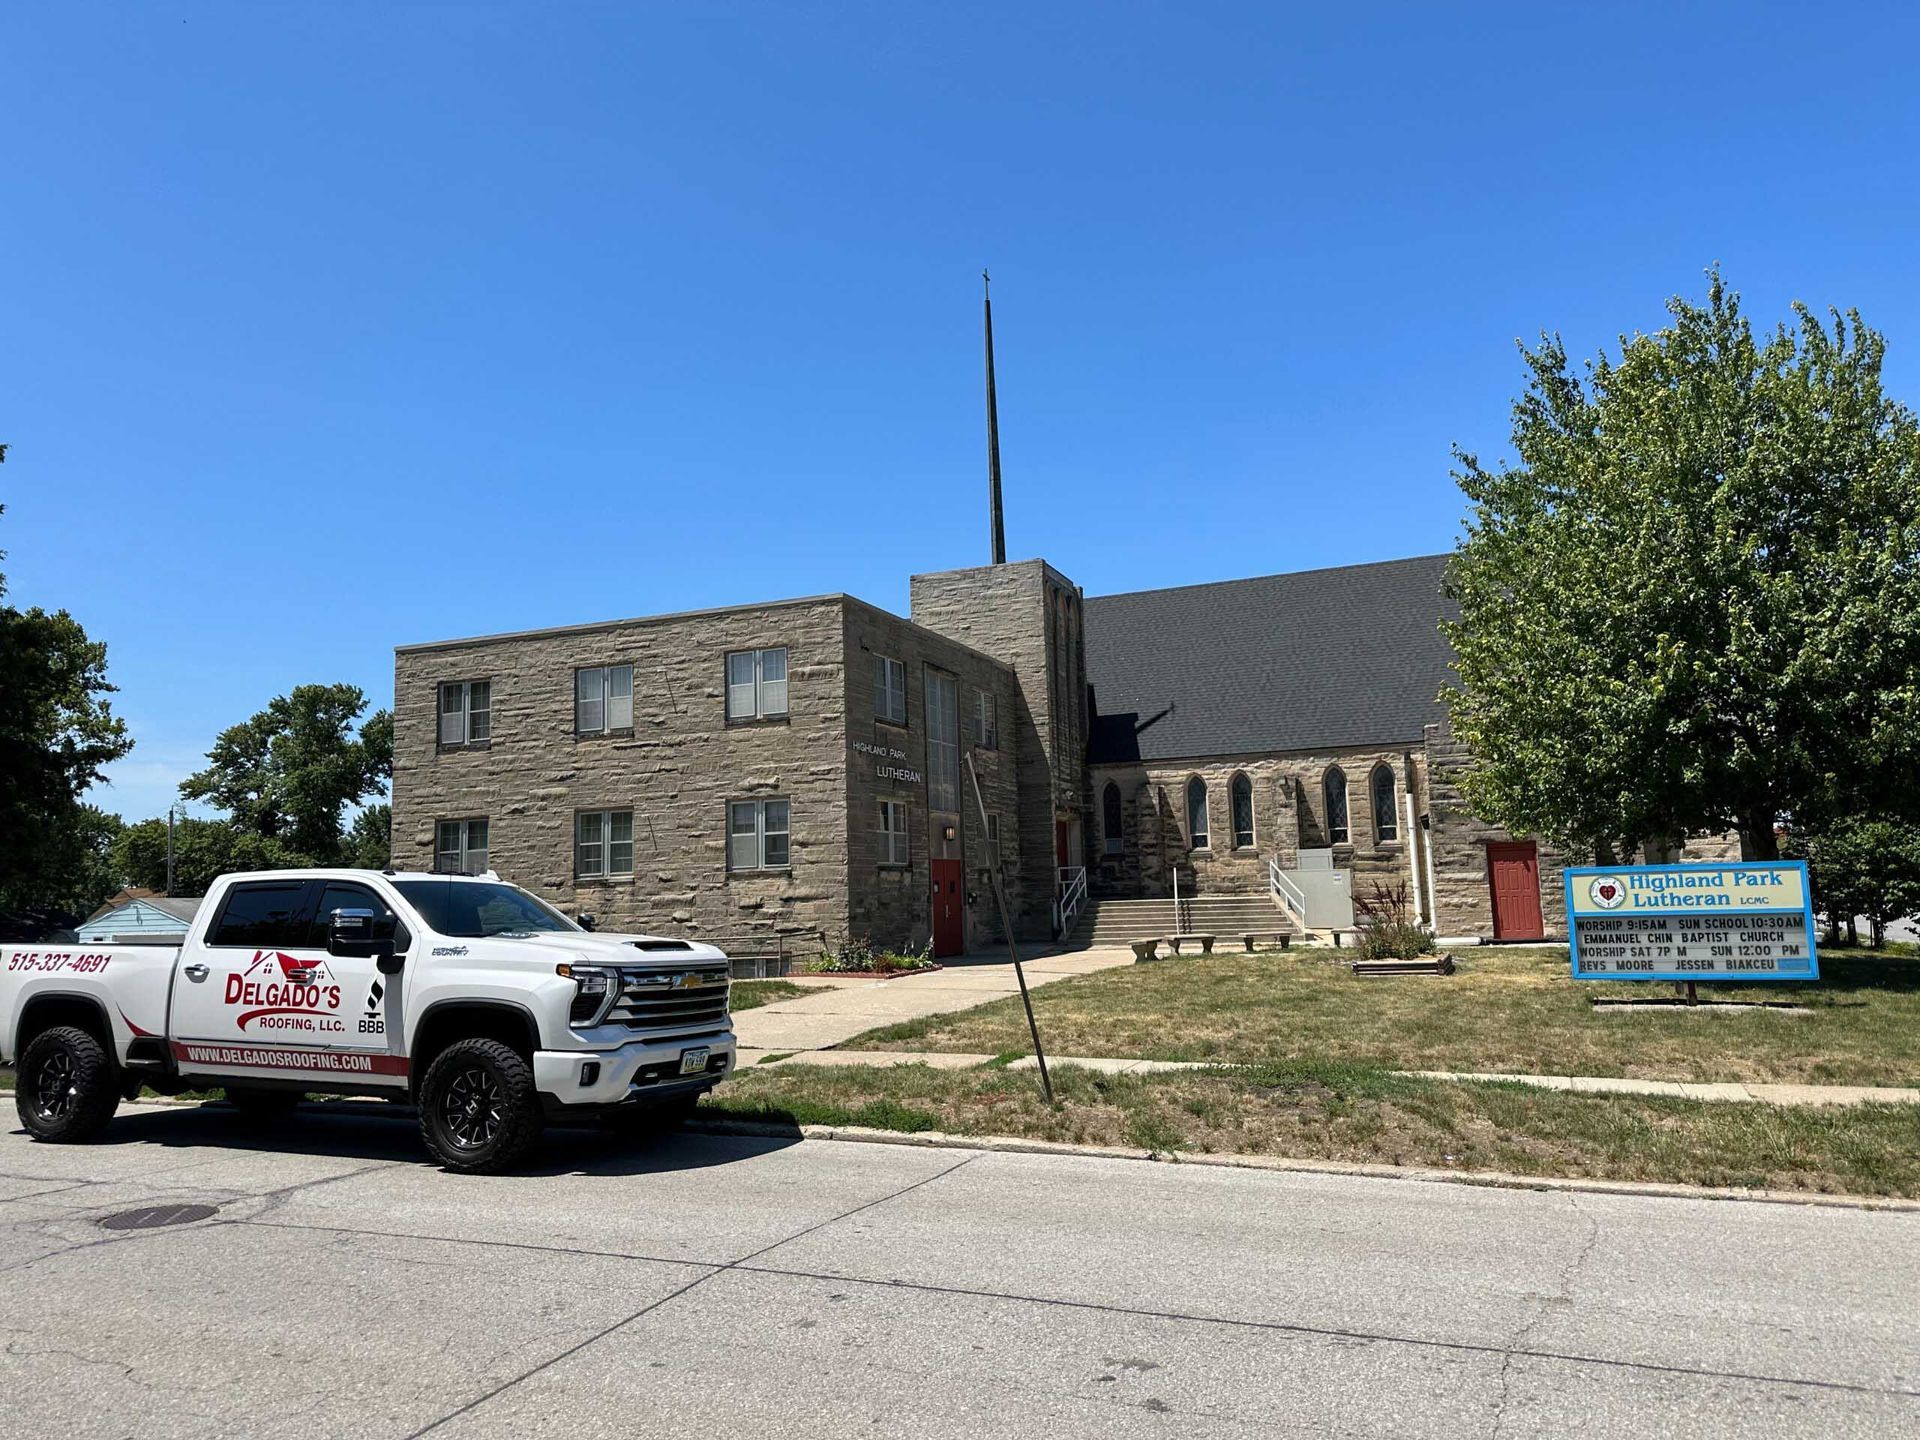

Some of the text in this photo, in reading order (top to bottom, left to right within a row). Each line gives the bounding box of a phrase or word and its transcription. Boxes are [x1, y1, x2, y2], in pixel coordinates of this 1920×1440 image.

[852, 740, 906, 760] HIGHLAND PARK
[877, 766, 920, 783] LUTHERAN
[1629, 870, 1783, 893] Highland Park
[1633, 892, 1770, 908] Lutheran LCMC
[1577, 916, 1803, 931] WORSHIP 9:15AM SUN SCHOOL 10:30AM
[1584, 931, 1784, 944] EMMANUEL CHIN BAPTIST CHURCH
[1580, 946, 1626, 957] WORSHIP
[1630, 946, 1652, 957] SAT
[1711, 945, 1733, 956] SUN
[1738, 945, 1771, 956] 12:00
[1782, 944, 1800, 955] PM
[8, 953, 112, 973] 515-337-4691
[1580, 959, 1775, 971] REVS MOORE JESSEN BIAKCEU
[224, 973, 341, 1009] DELGADO'S
[259, 1017, 345, 1032] ROOFING, LLC.
[358, 1020, 385, 1034] BBB
[187, 1046, 373, 1071] WWW.DELGADOSROOFING.COM
